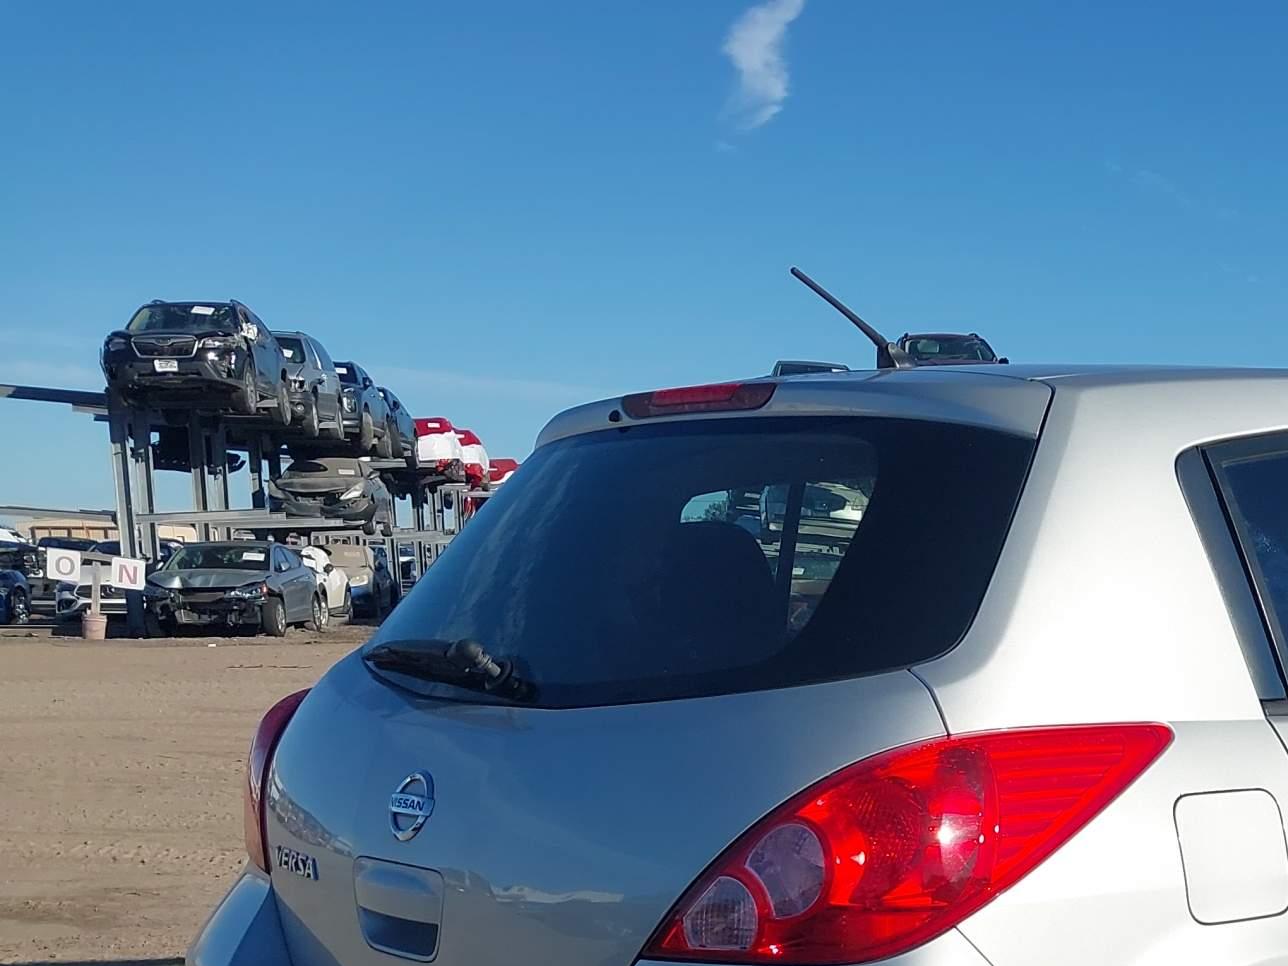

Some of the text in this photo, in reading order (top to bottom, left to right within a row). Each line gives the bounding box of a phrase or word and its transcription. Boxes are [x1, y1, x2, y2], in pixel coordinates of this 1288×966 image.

[55, 556, 75, 576] O
[118, 564, 138, 585] N
[275, 845, 319, 881] VERSA
